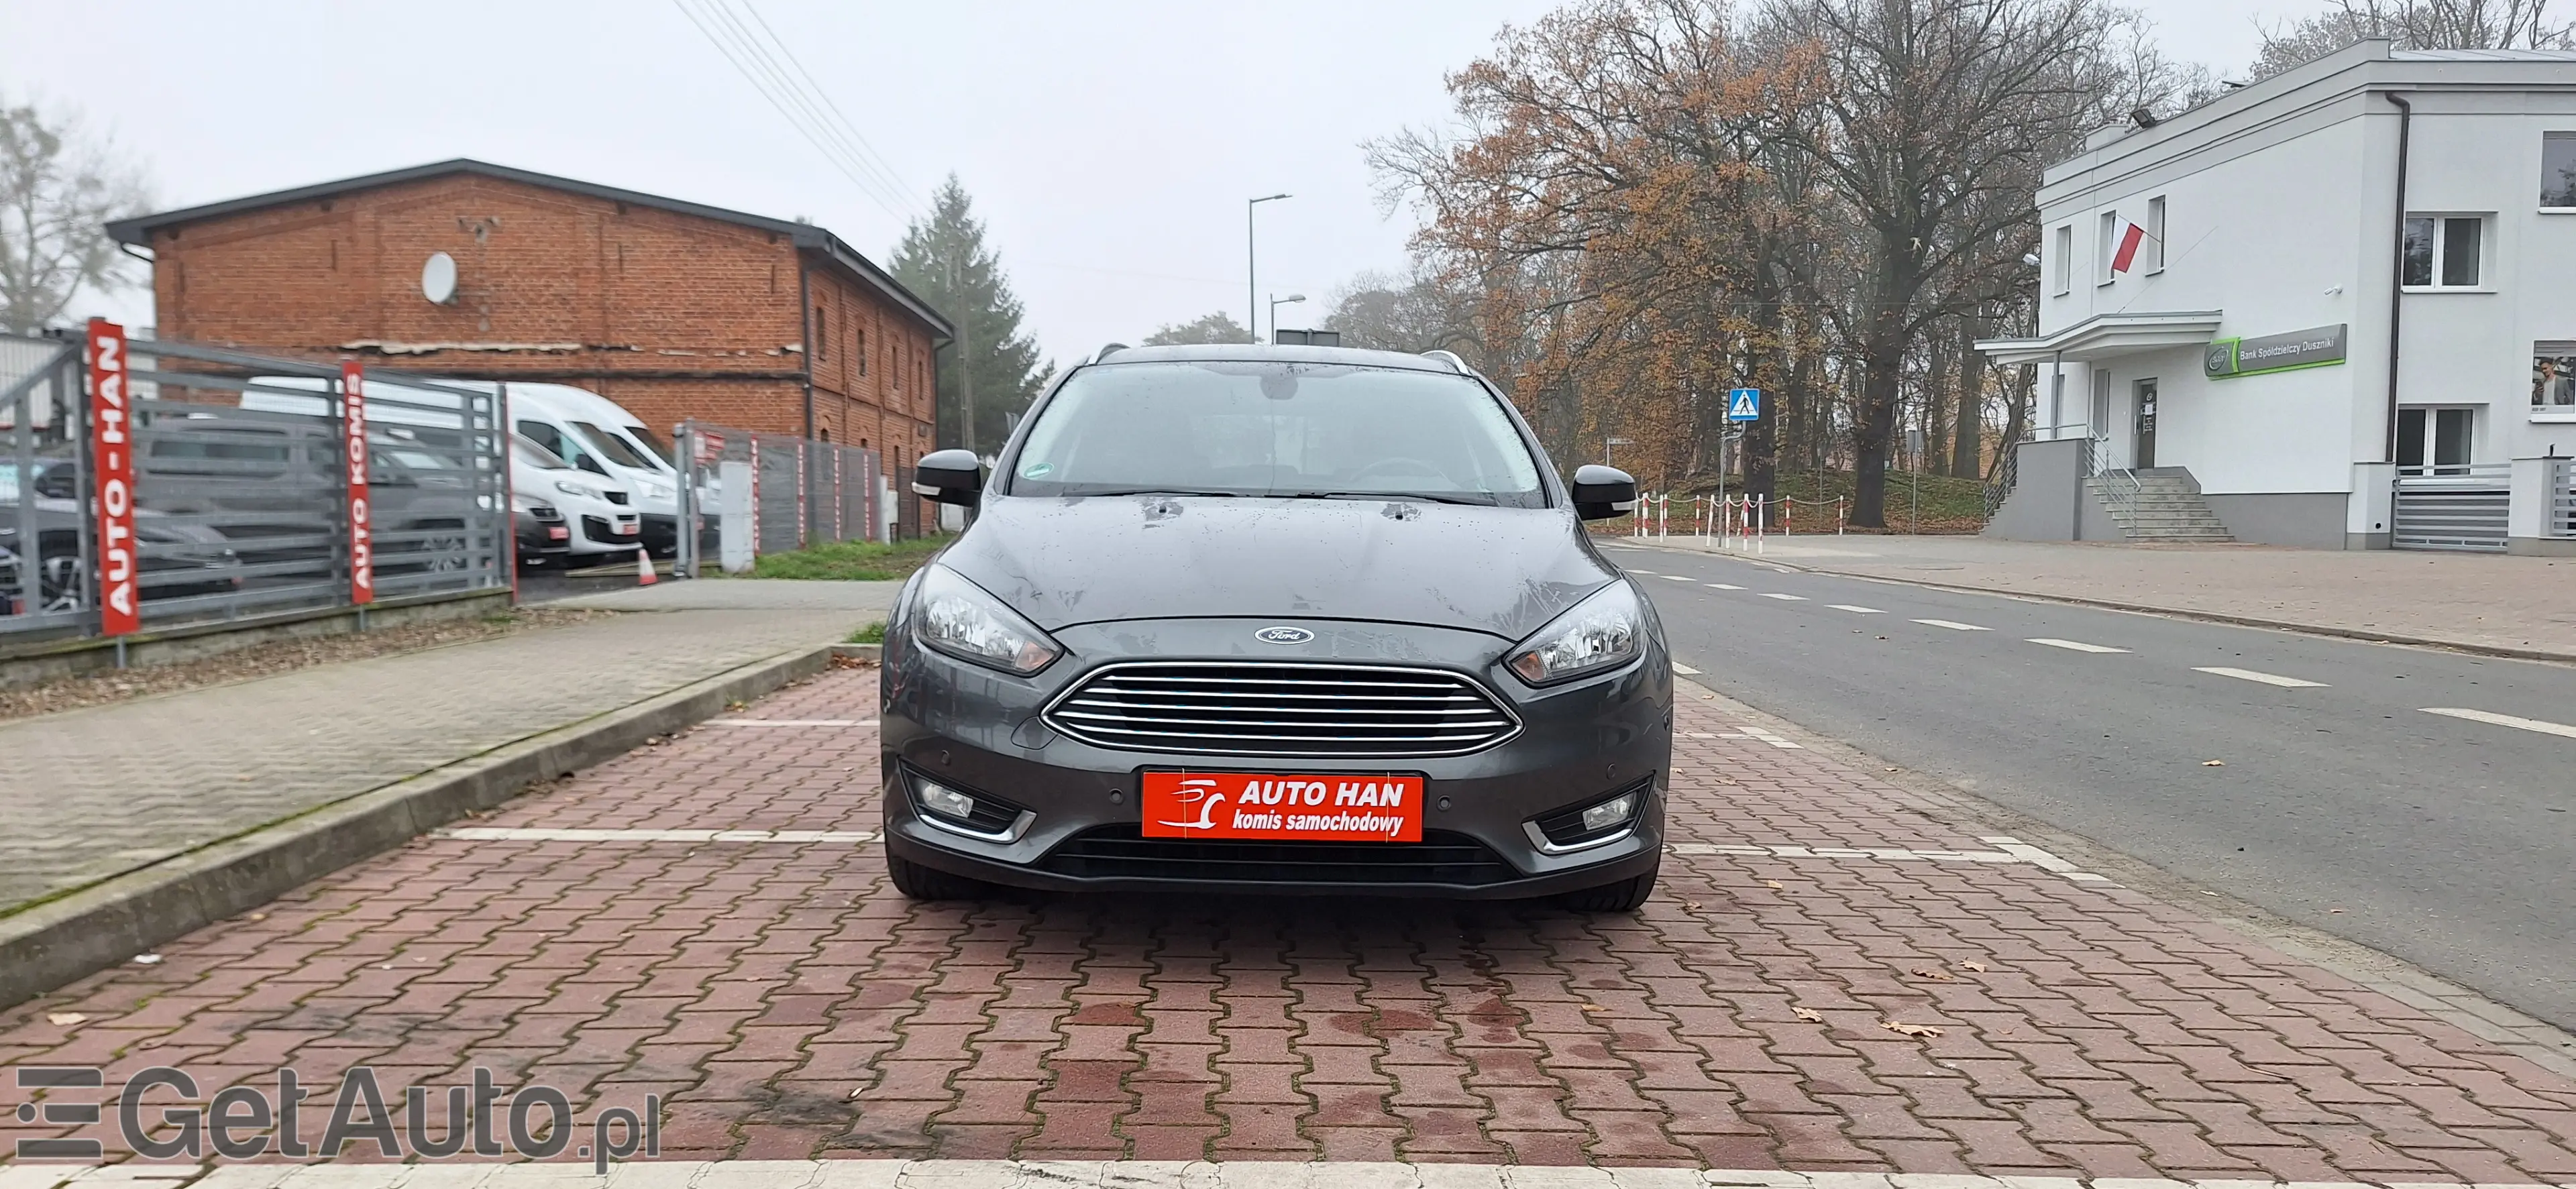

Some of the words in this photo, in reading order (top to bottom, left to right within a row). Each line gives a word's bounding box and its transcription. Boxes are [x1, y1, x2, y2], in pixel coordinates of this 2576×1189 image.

[2240, 349, 2257, 361] Bank
[2302, 337, 2334, 352] Duszniki
[346, 373, 366, 486] KOMIS
[352, 497, 370, 589] AUTO
[1268, 630, 1301, 640] Ford
[1238, 781, 1327, 806] AUTO
[1335, 782, 1404, 807] HAN
[1232, 809, 1283, 830] komis
[1286, 810, 1404, 837] samochodowy
